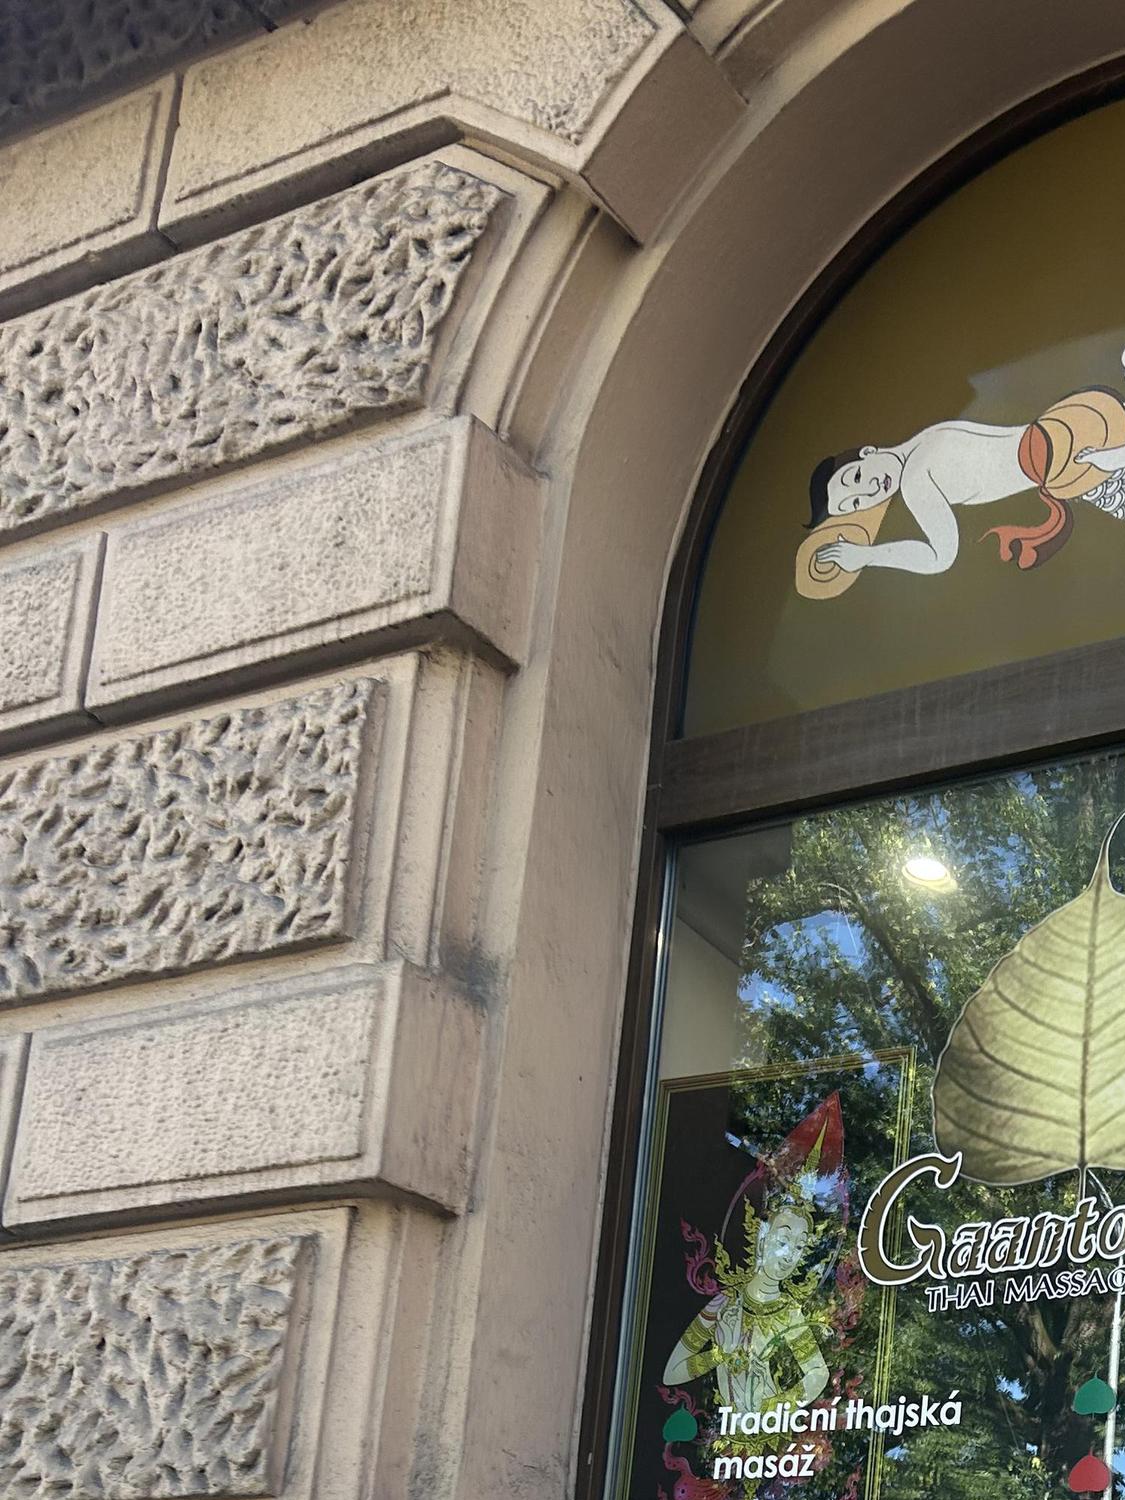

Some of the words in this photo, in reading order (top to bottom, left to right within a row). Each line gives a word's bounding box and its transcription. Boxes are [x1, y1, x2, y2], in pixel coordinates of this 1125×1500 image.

[925, 1281, 994, 1313] THAI
[718, 1397, 840, 1436] Tradiční
[845, 1390, 962, 1436] thajská
[713, 1445, 815, 1480] masáž
